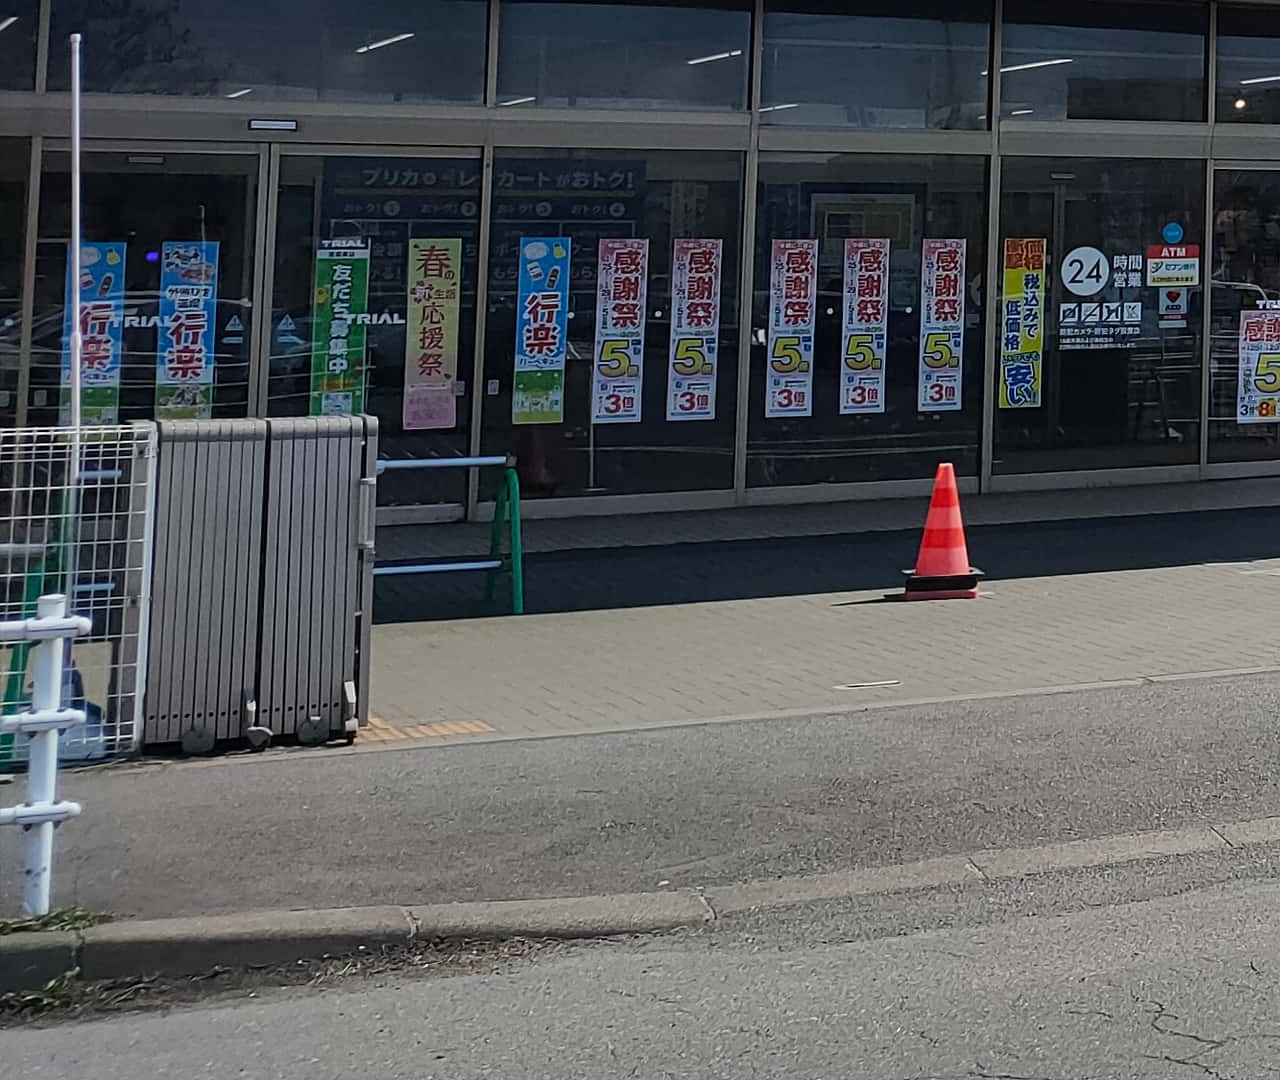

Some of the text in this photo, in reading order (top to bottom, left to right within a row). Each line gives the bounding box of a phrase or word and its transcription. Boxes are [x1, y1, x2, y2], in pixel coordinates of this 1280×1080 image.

[322, 239, 365, 248] TRIAL
[1068, 259, 1103, 284] 24
[1113, 254, 1143, 270] 時間
[1161, 247, 1186, 257] ATM
[612, 248, 642, 329] 感謝祭
[686, 248, 716, 329] 感謝祭
[783, 248, 813, 325] 感謝祭
[856, 248, 885, 324] 感謝祭
[933, 247, 961, 324] 感謝祭
[1023, 273, 1041, 339] 税込みで
[1113, 272, 1143, 288] 営業
[79, 303, 114, 370] 行楽
[167, 312, 208, 380] 行楽
[345, 313, 405, 325] TRIAL
[524, 292, 561, 356] 行楽
[1004, 300, 1022, 352] 低価格
